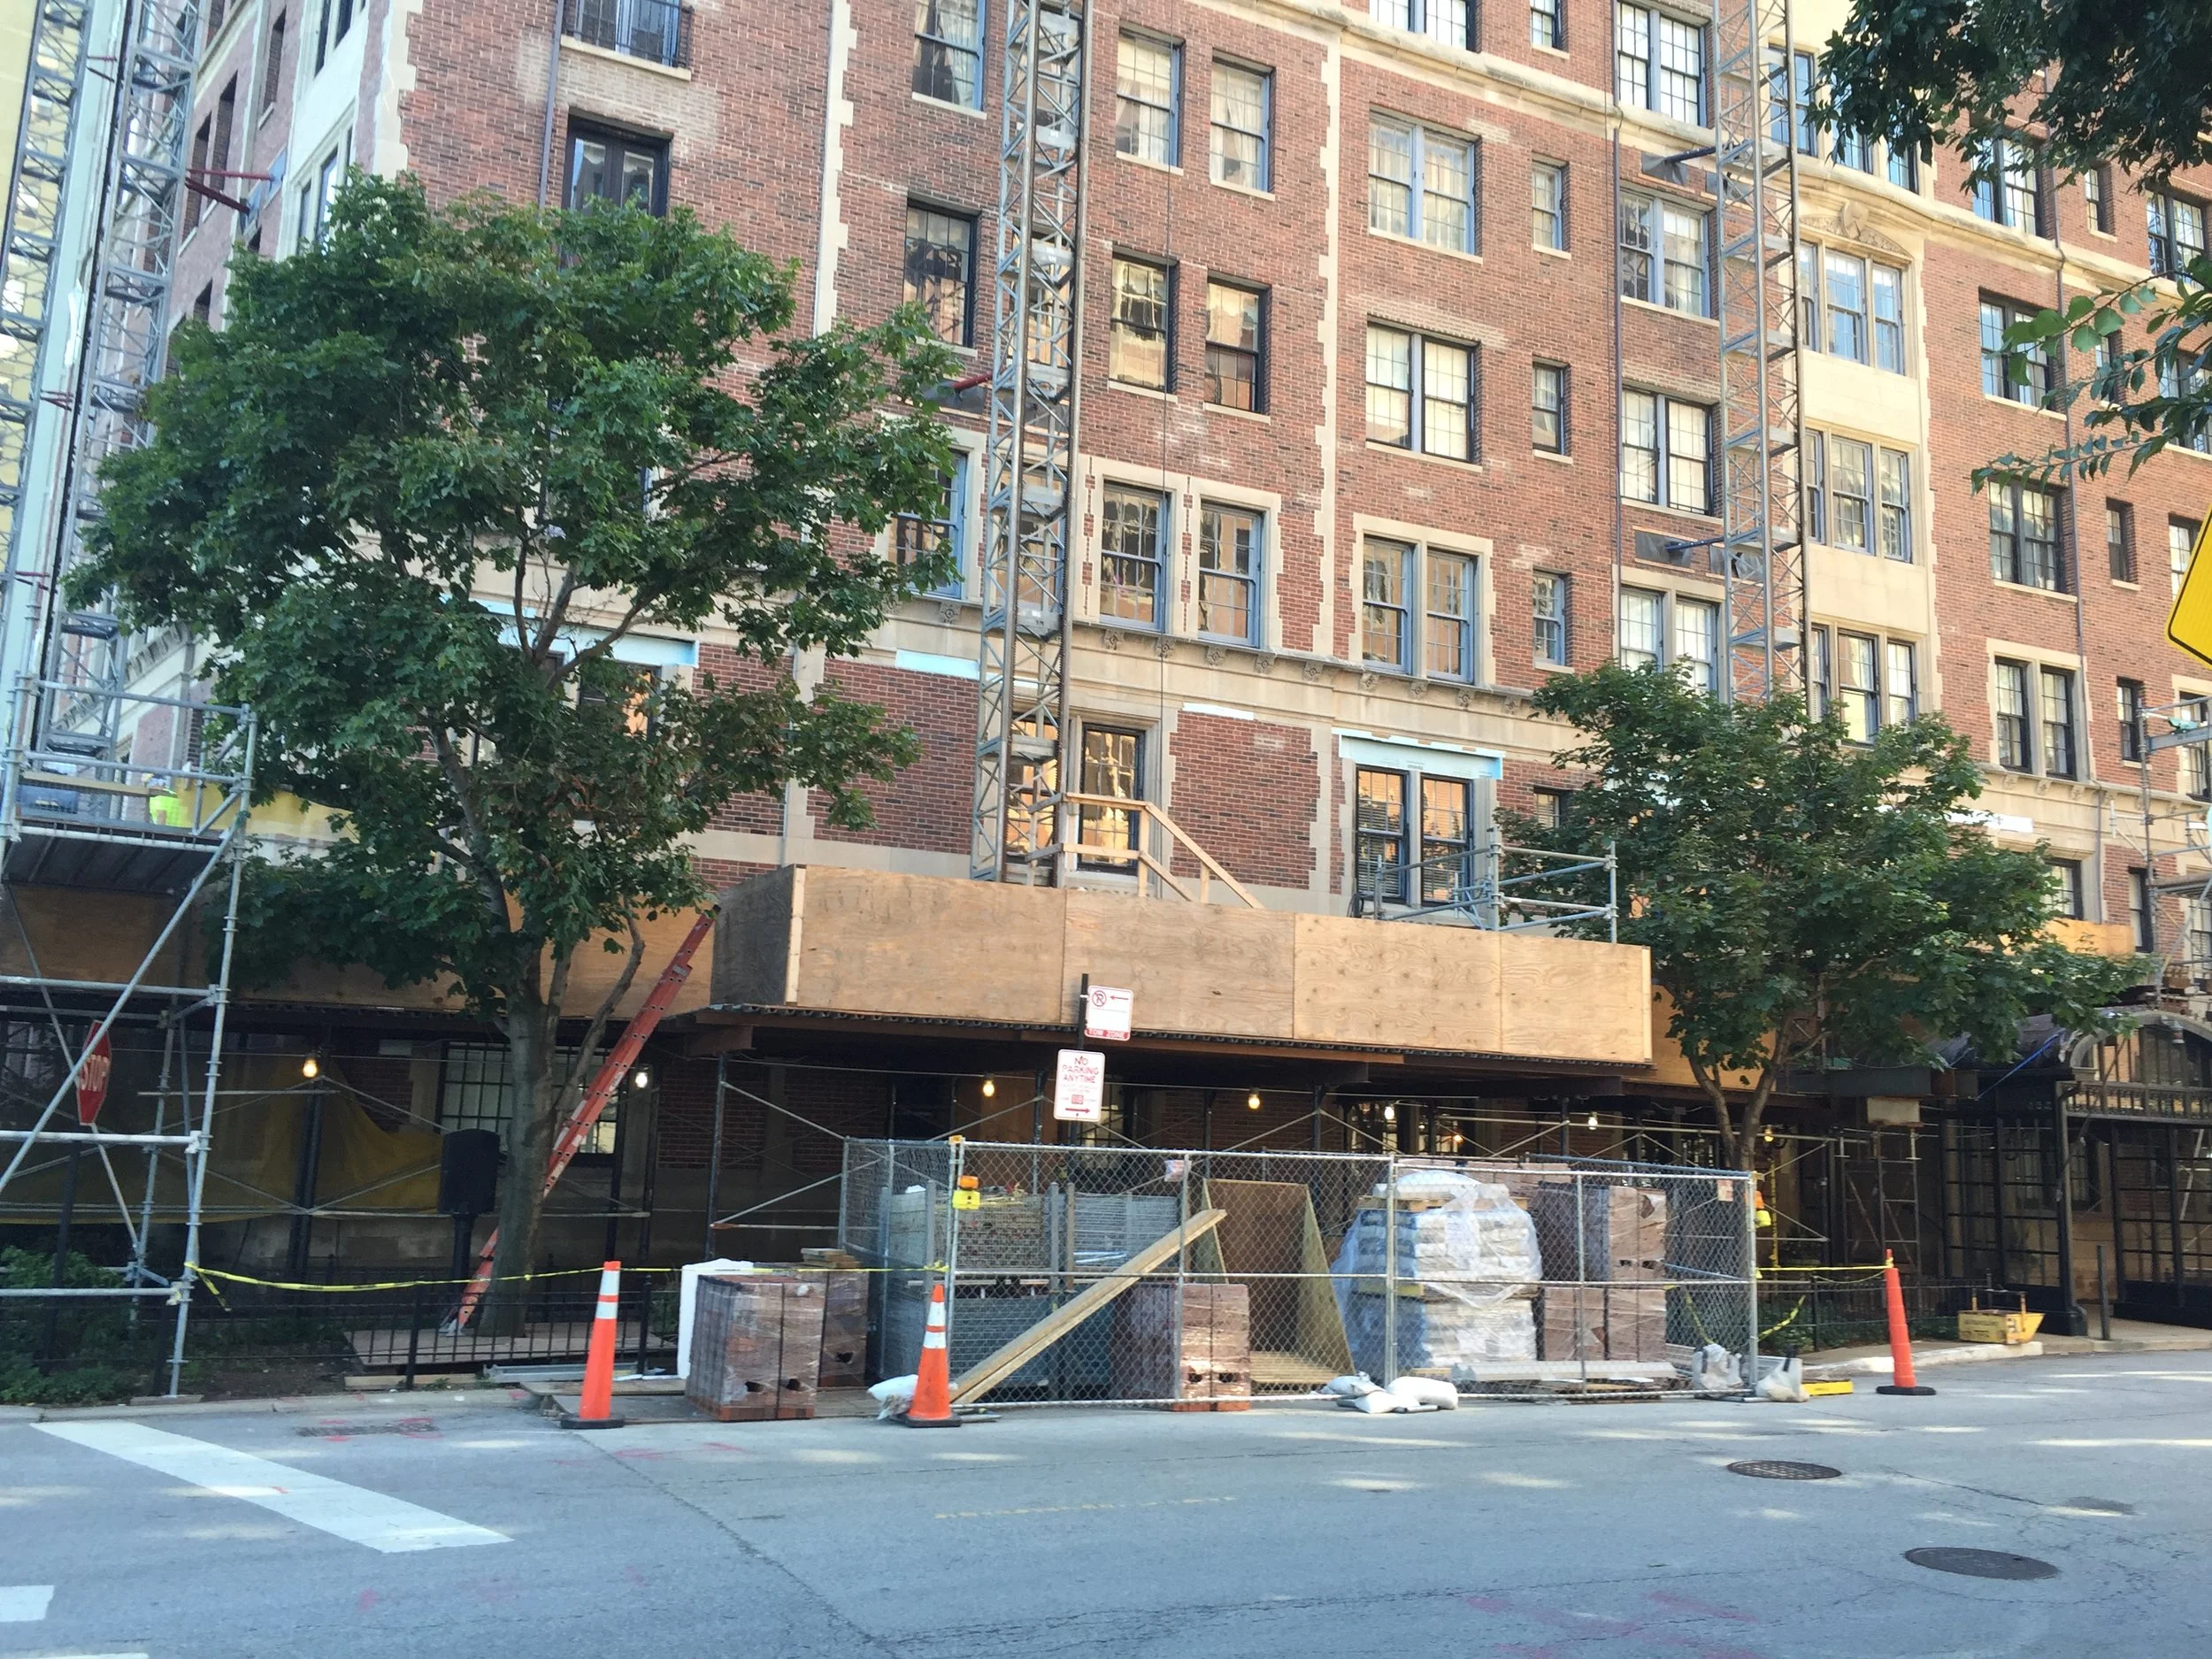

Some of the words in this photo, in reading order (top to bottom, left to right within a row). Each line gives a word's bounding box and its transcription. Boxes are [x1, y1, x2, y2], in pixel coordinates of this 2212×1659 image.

[1088, 1028, 1103, 1037] TOW
[1108, 1030, 1125, 1040] ZONE
[79, 1054, 111, 1092] STOP
[1062, 1064, 1099, 1075] PARKING
[1064, 1073, 1096, 1084] ANYTIME
